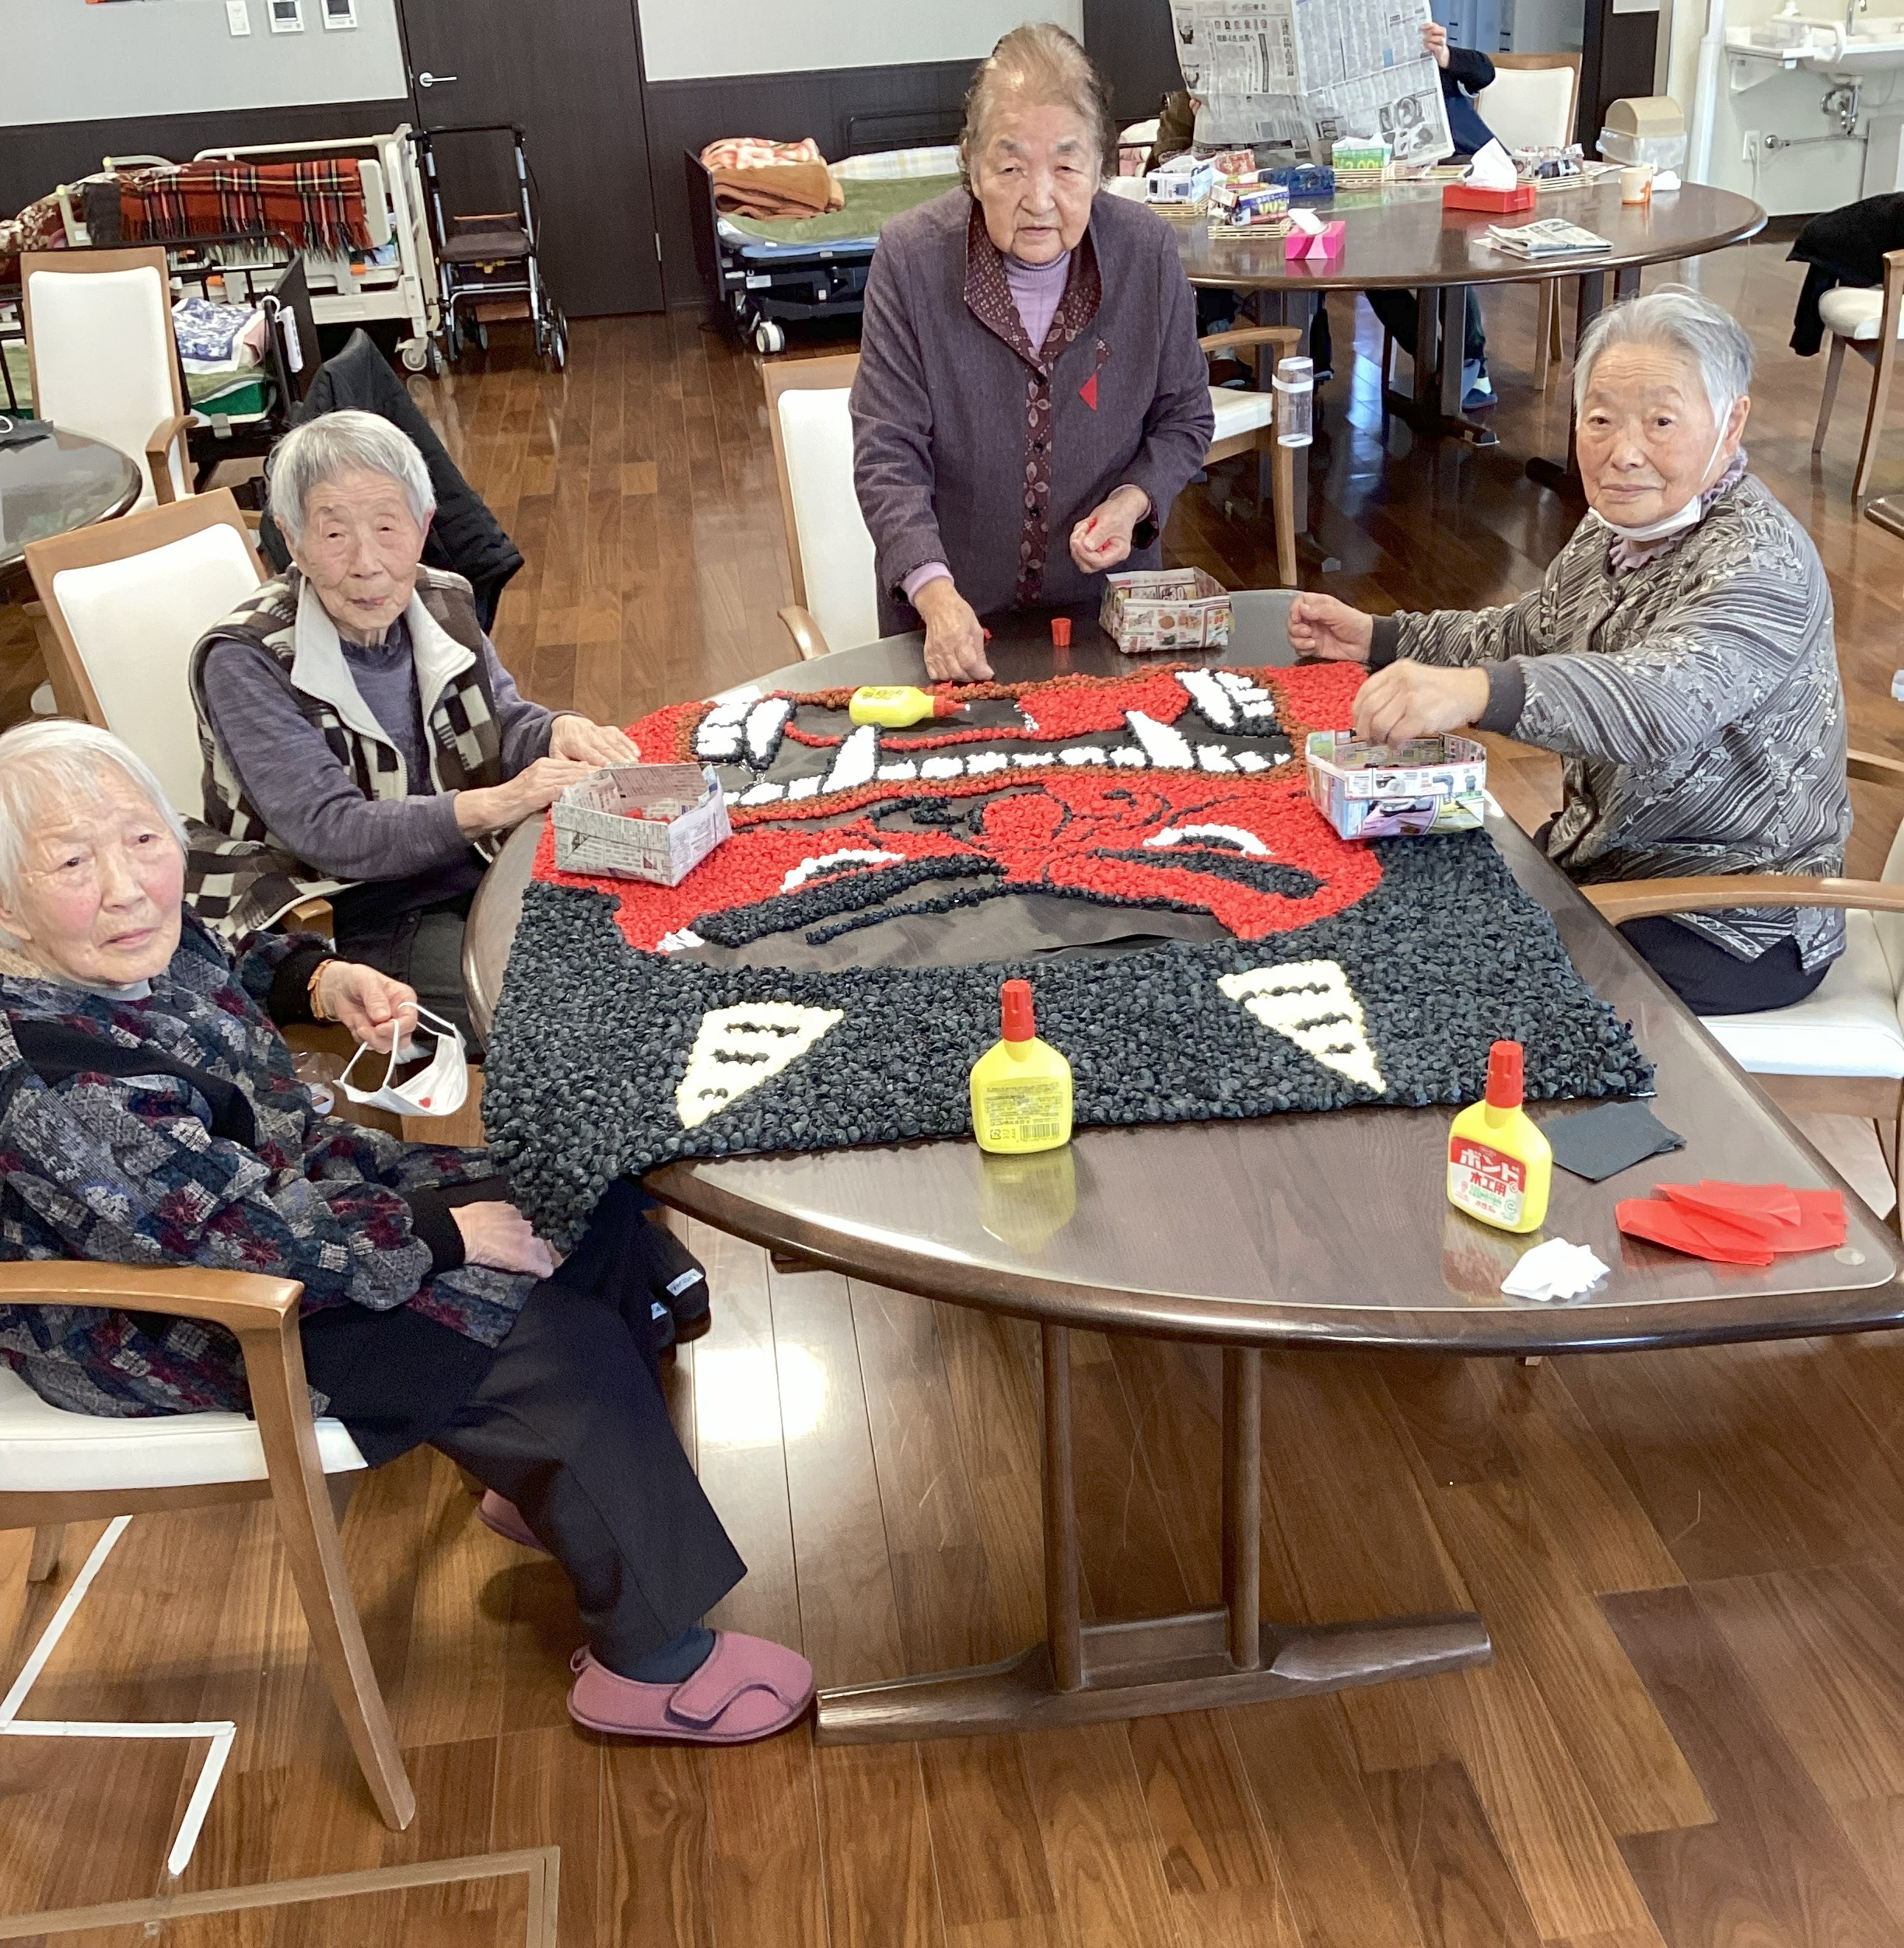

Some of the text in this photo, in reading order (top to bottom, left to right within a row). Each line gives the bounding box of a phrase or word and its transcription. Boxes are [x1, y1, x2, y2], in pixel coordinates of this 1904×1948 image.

[1459, 1148, 1521, 1182] ボンド
[1470, 1171, 1507, 1197] 木工用
